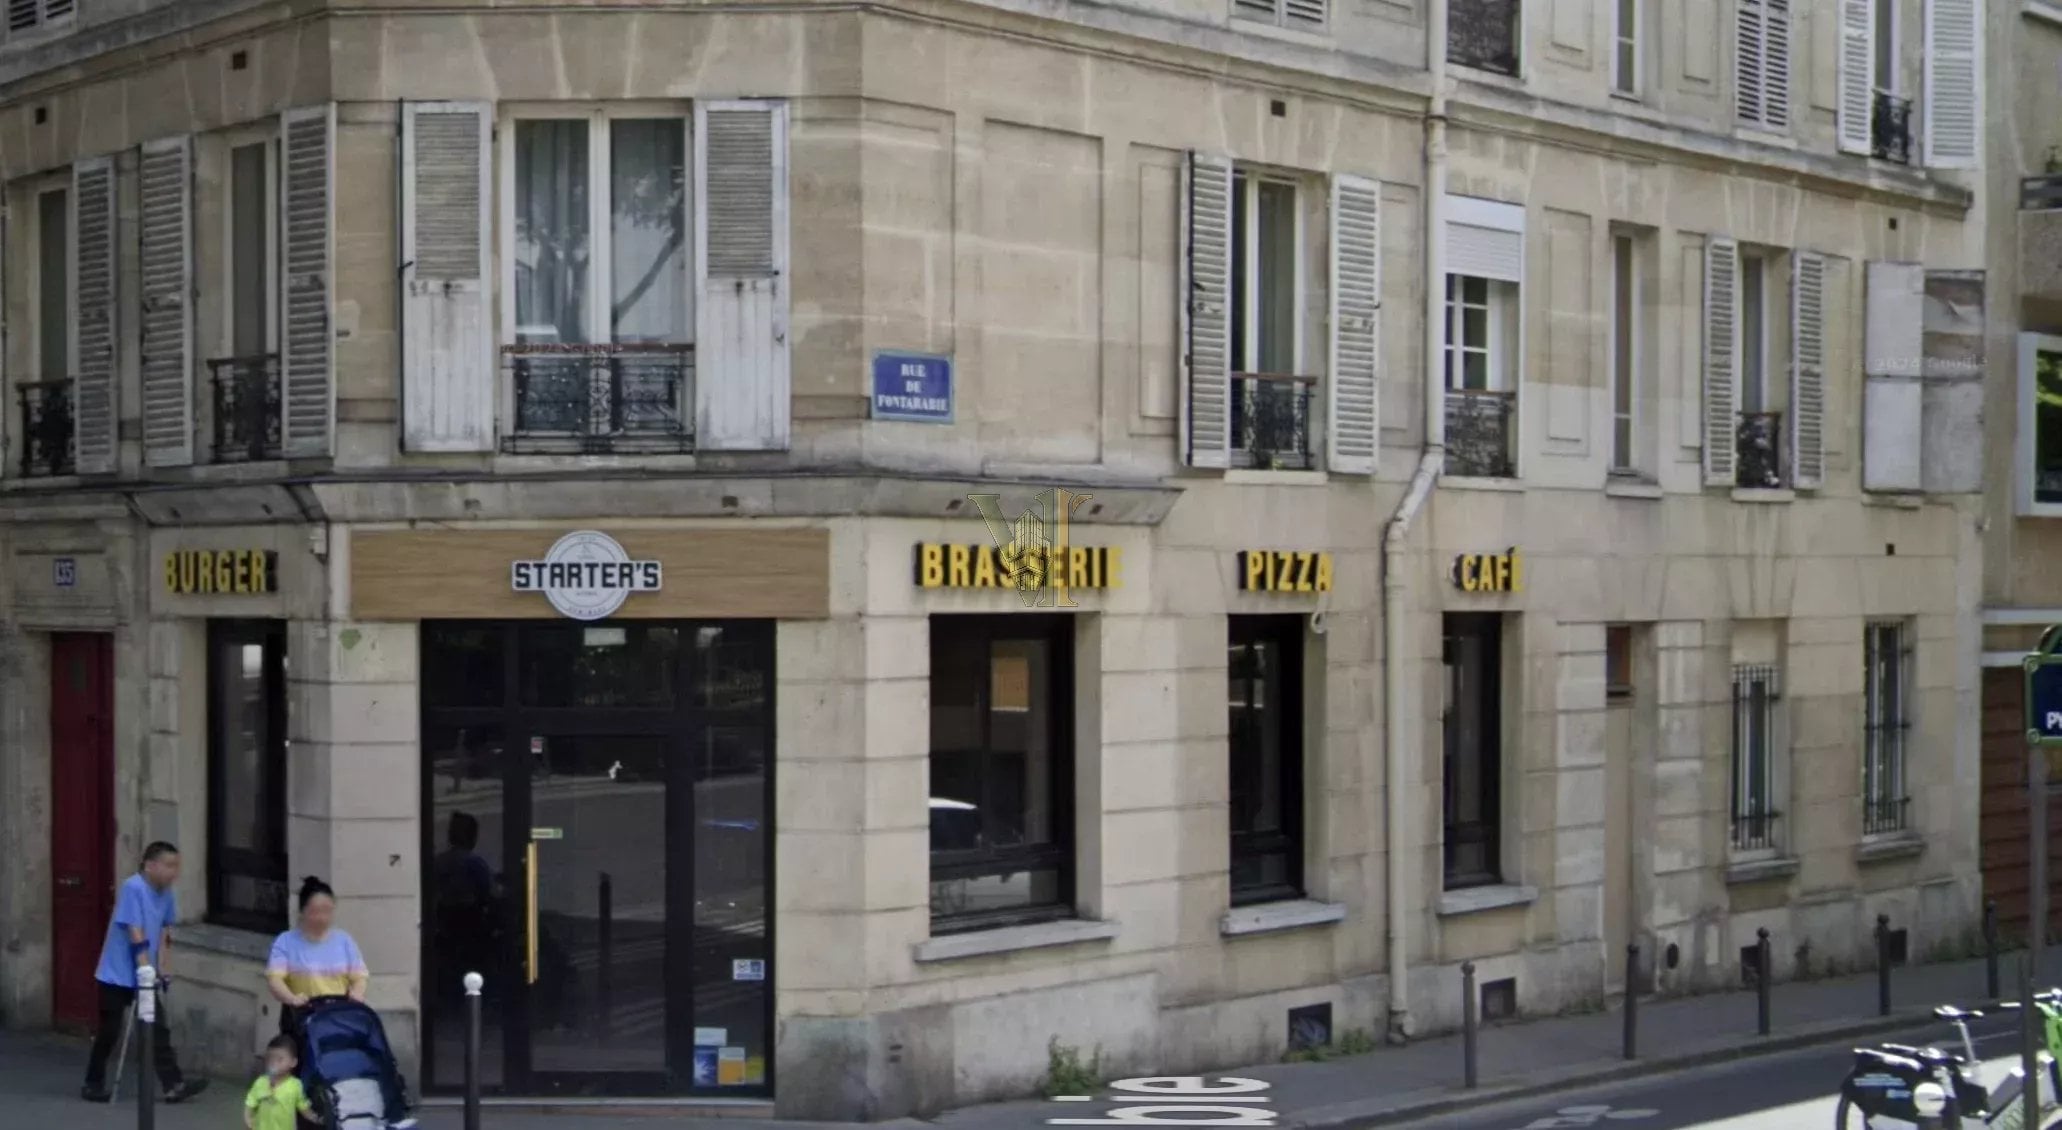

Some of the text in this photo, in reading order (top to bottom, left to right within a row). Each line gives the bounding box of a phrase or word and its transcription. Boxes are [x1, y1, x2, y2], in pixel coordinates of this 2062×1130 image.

[901, 363, 927, 377] RUE
[905, 380, 921, 393] DE
[877, 394, 948, 411] FONTARABIE
[163, 548, 270, 593] BURGER
[514, 562, 659, 588] STARTER'S
[1244, 551, 1333, 592] PIZZA
[1461, 544, 1524, 592] CAFÉ
